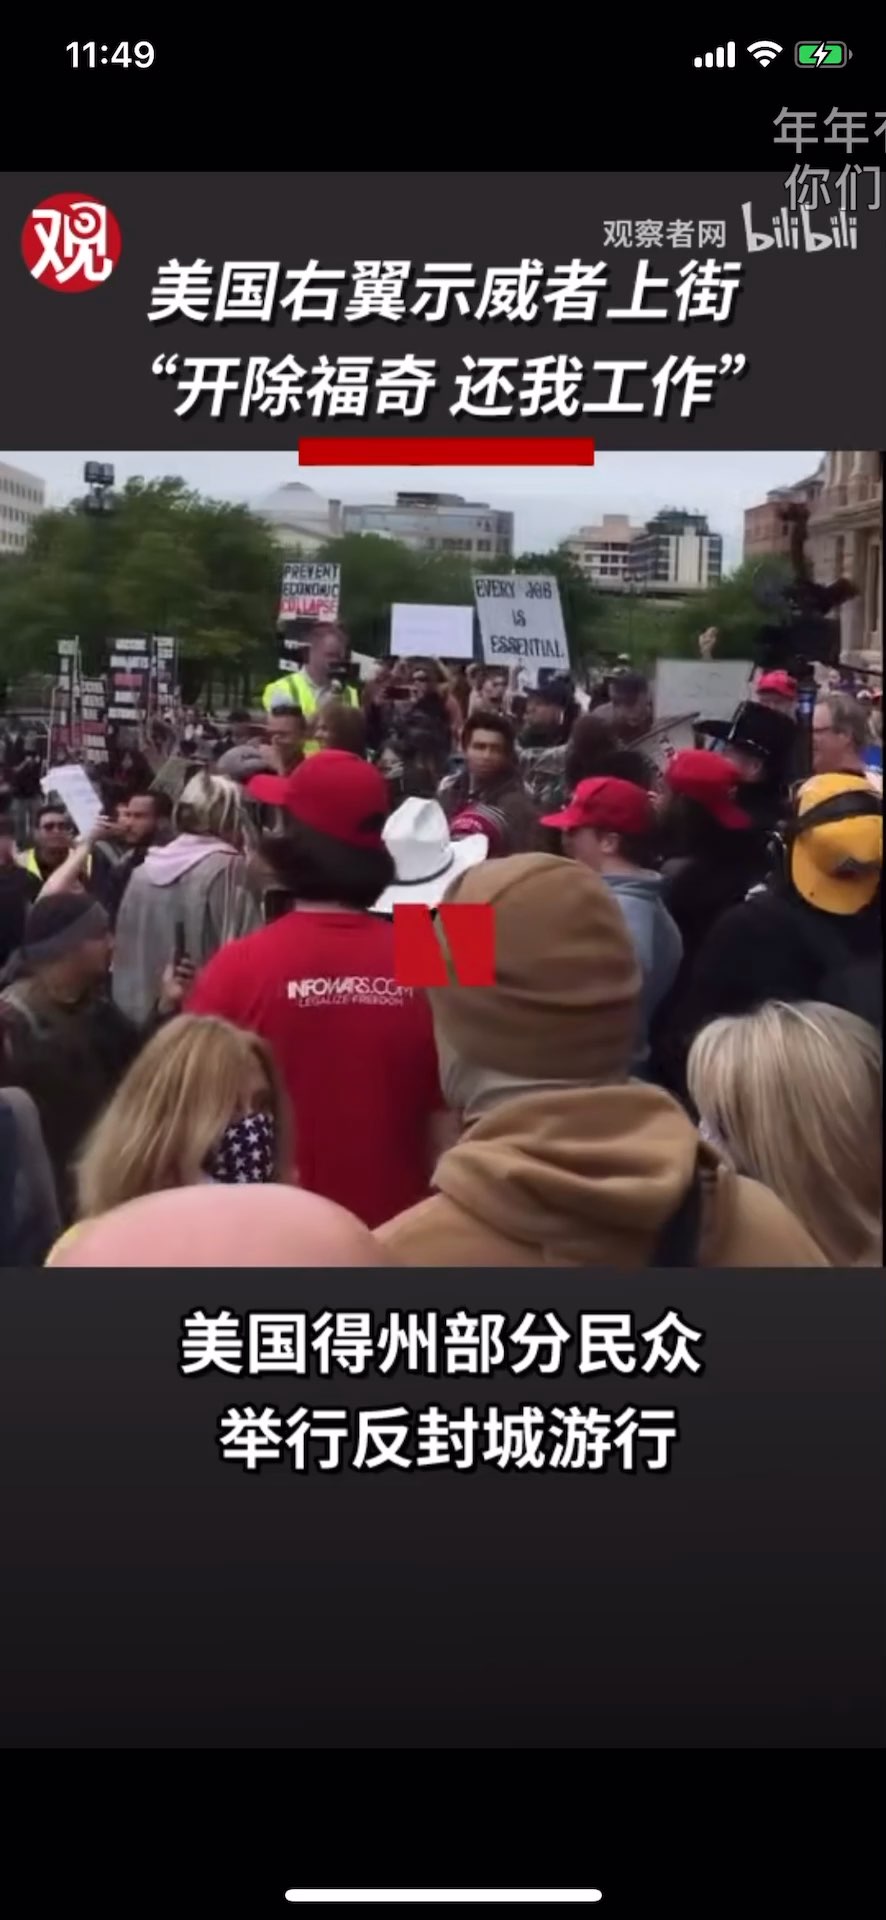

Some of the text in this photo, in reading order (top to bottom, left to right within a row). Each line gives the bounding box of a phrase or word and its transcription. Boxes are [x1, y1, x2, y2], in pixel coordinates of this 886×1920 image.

[283, 564, 339, 578] PREVENT
[283, 582, 339, 597] ECONOMIC
[476, 579, 552, 599] EVERY JOB
[281, 599, 337, 614] COLLAPSE
[512, 608, 526, 628] IS
[490, 635, 565, 658] ESSENTIAL
